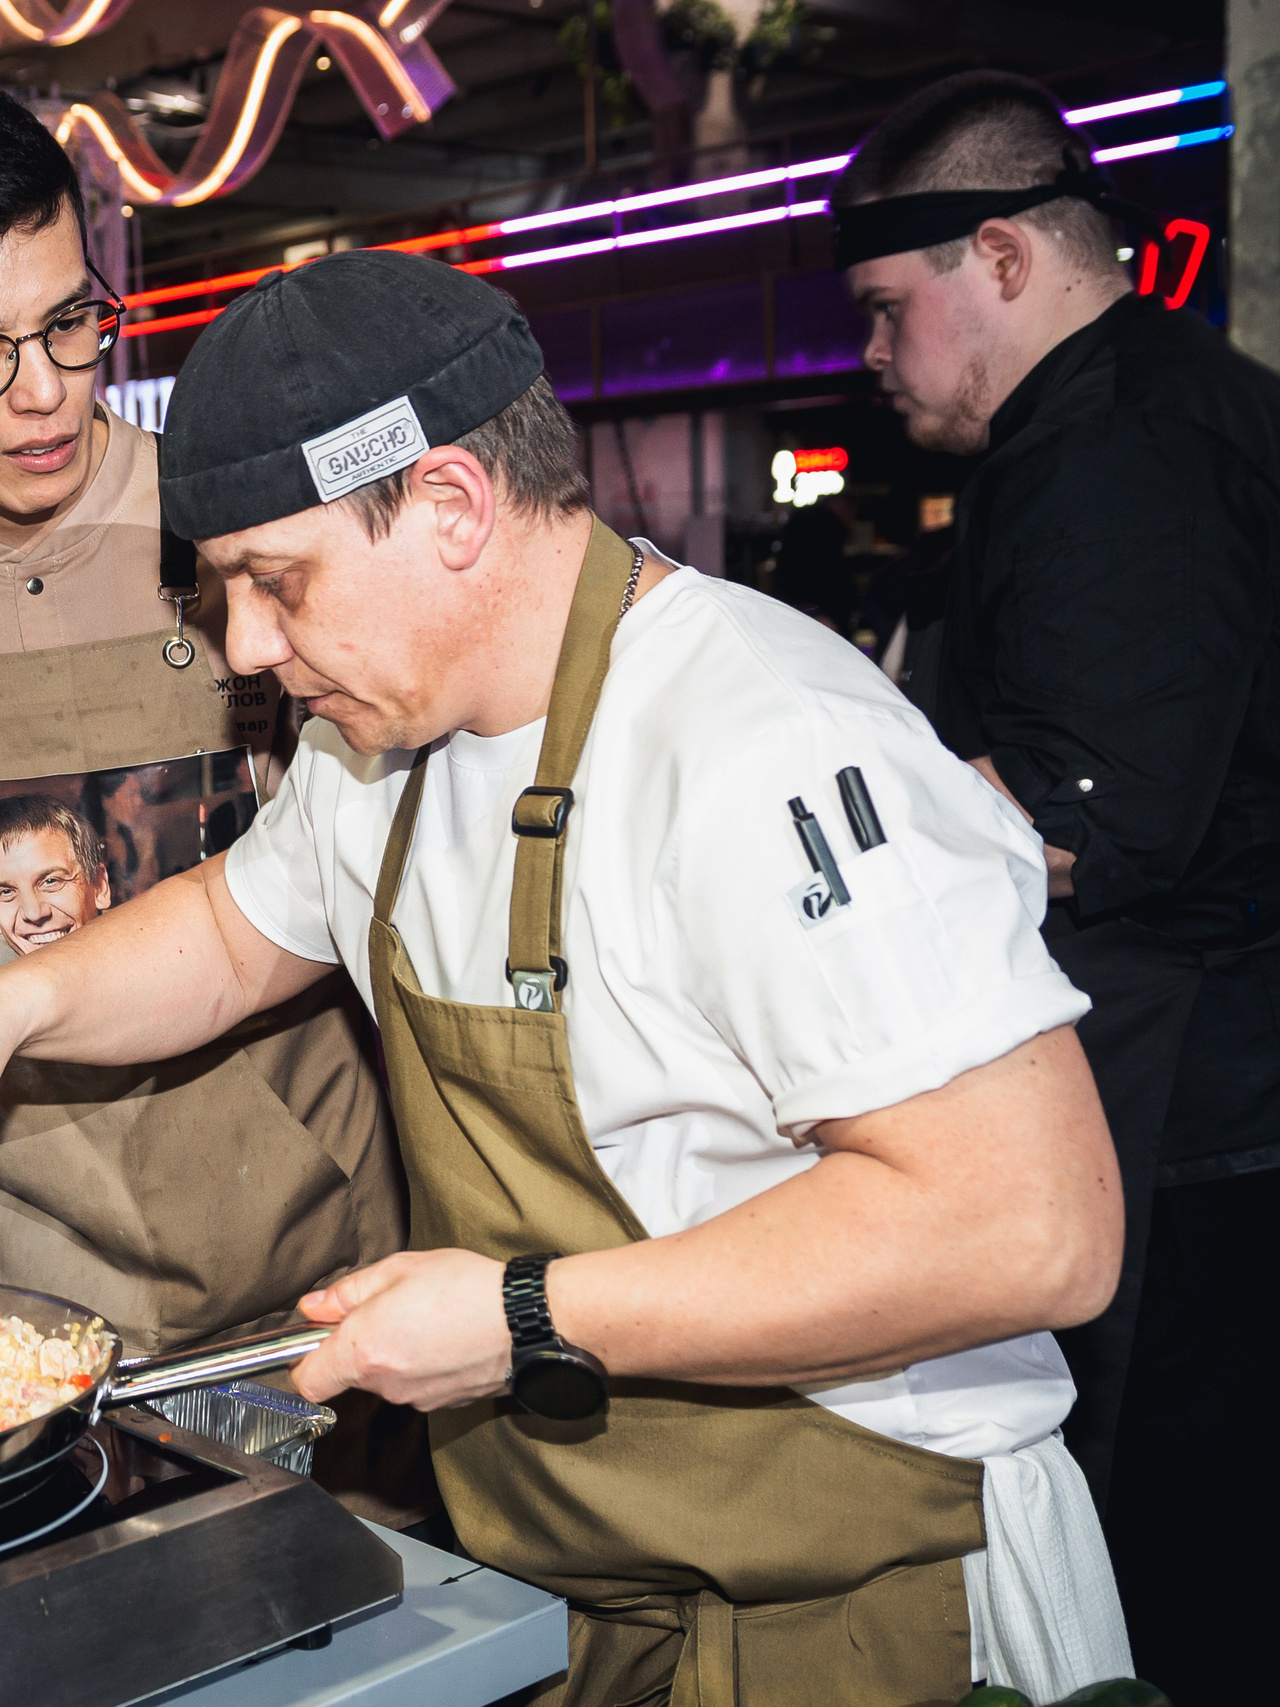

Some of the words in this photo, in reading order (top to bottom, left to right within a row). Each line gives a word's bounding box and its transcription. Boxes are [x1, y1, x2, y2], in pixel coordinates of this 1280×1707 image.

[350, 427, 368, 440] THE
[328, 425, 407, 475] GAUCHO
[351, 456, 398, 481] AUTHENTIC
[221, 691, 267, 709] ЛОВ
